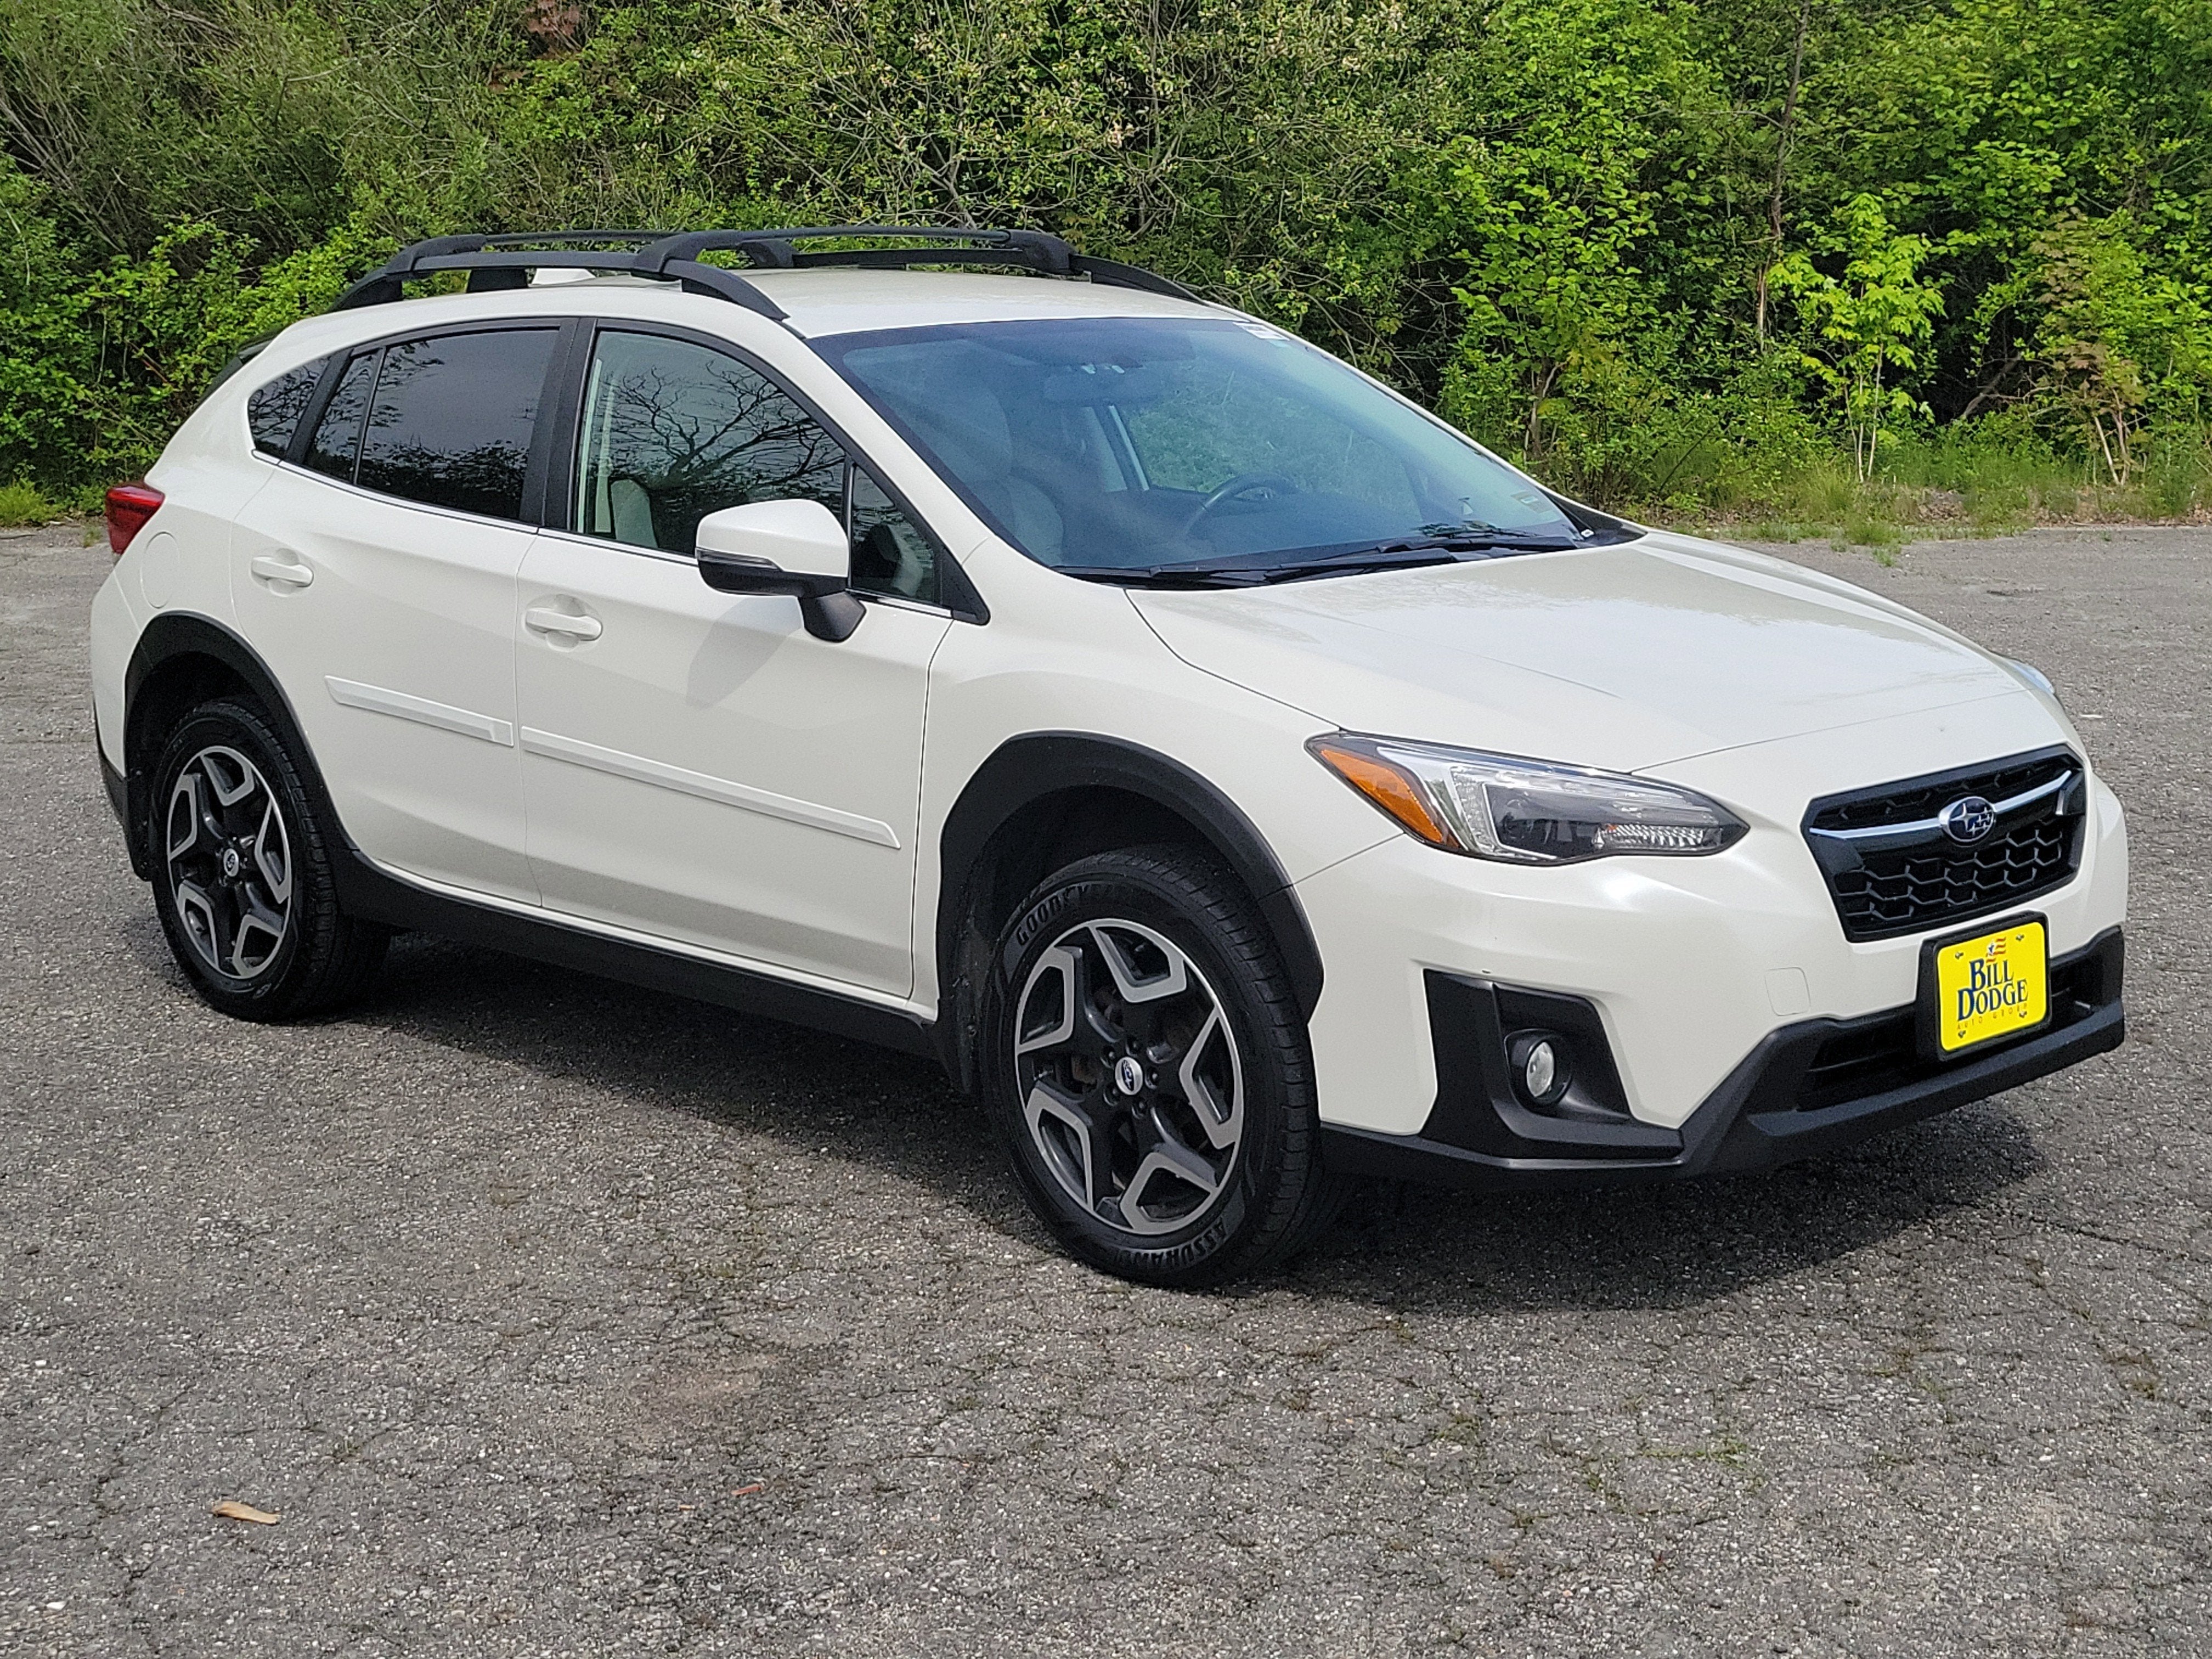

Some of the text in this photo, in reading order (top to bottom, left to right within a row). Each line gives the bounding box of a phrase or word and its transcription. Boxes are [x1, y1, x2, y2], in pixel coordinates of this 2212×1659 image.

[1015, 884, 1090, 946] GOODY
[1969, 958, 2015, 992] BILL
[1957, 978, 2029, 1022] DODGE
[1114, 1216, 1227, 1268] ASSURAN
